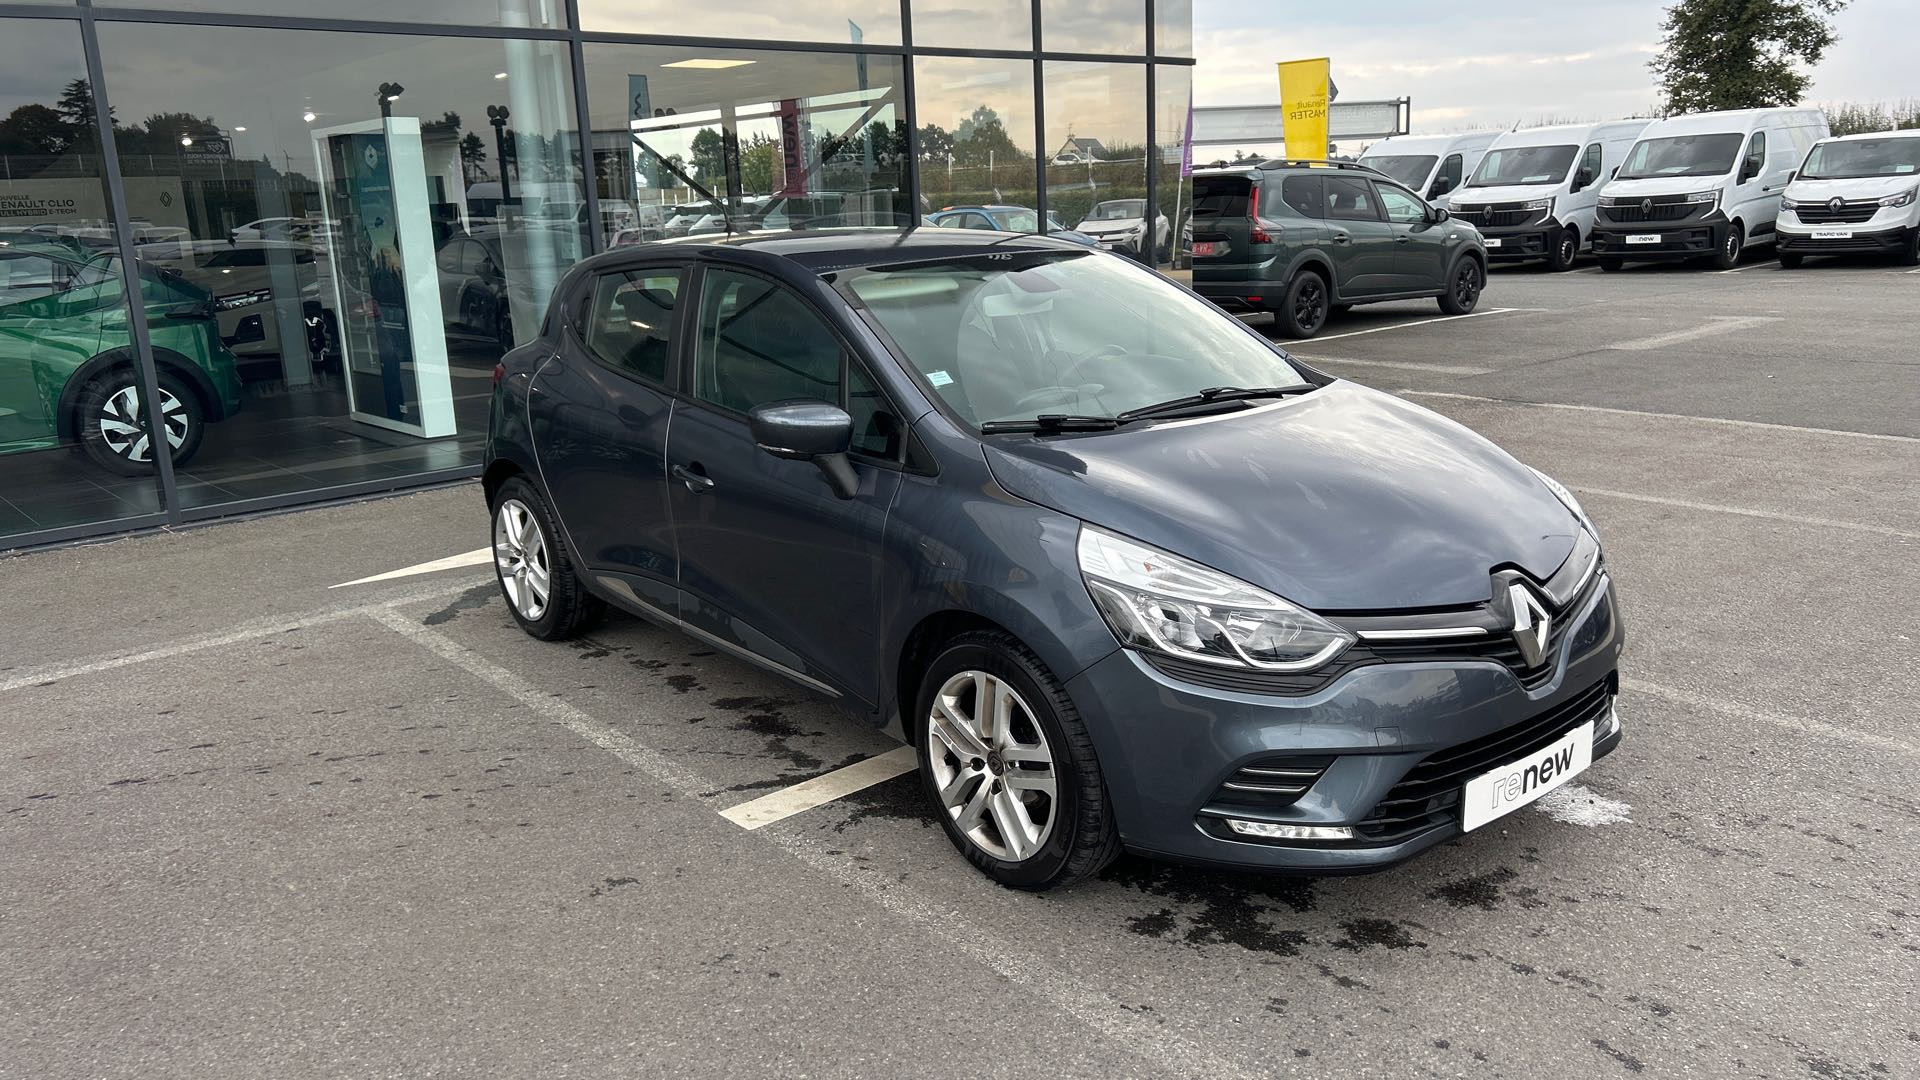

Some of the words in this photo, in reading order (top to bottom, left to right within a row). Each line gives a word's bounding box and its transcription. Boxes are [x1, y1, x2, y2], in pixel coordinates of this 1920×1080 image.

[0, 200, 45, 209] ENAULT
[48, 199, 75, 208] CLIO
[1491, 742, 1575, 810] renew
